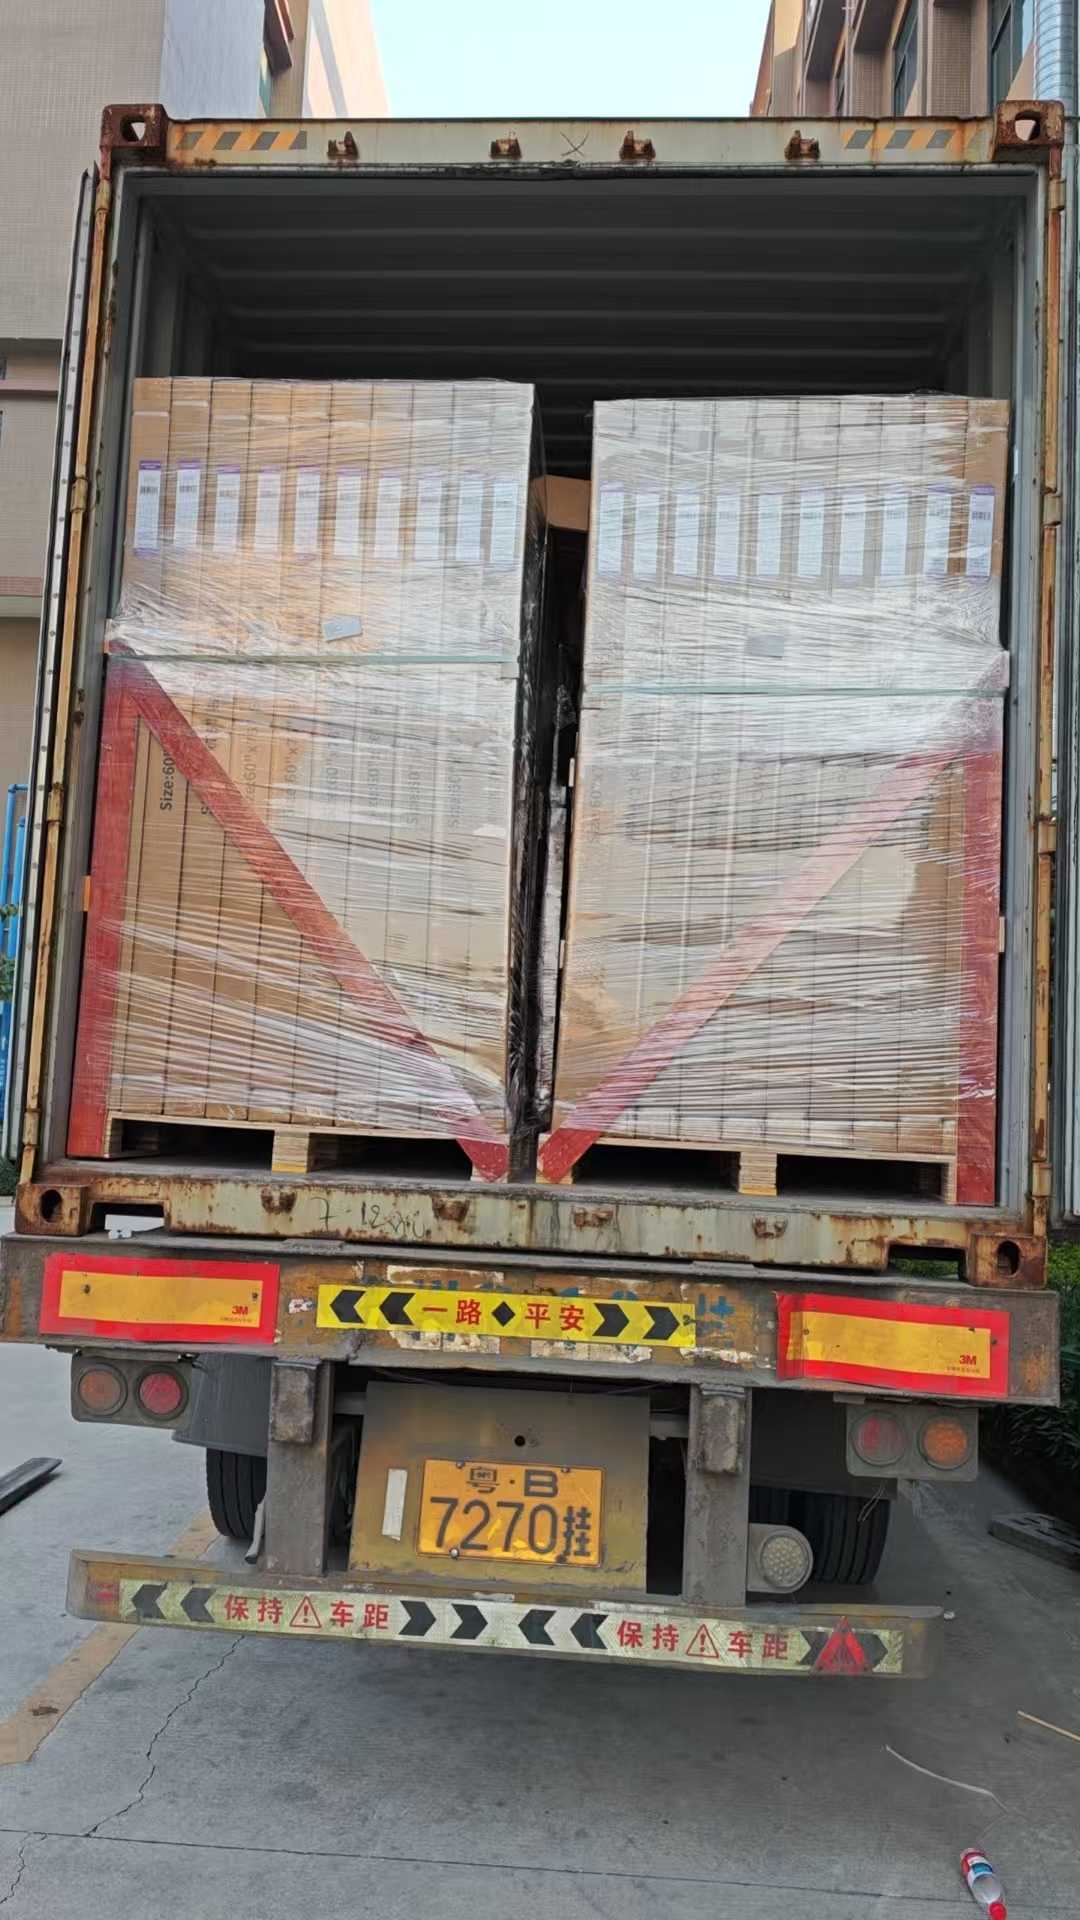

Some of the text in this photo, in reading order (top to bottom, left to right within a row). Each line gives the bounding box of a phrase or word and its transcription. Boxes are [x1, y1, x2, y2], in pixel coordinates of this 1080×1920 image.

[231, 1305, 249, 1316] 3M
[422, 1298, 585, 1332] 一路 平安
[959, 1354, 977, 1366] 3M
[430, 1496, 592, 1558] 7270挂
[224, 1592, 389, 1630] 保持 车距
[617, 1619, 790, 1660] 保持 车距
